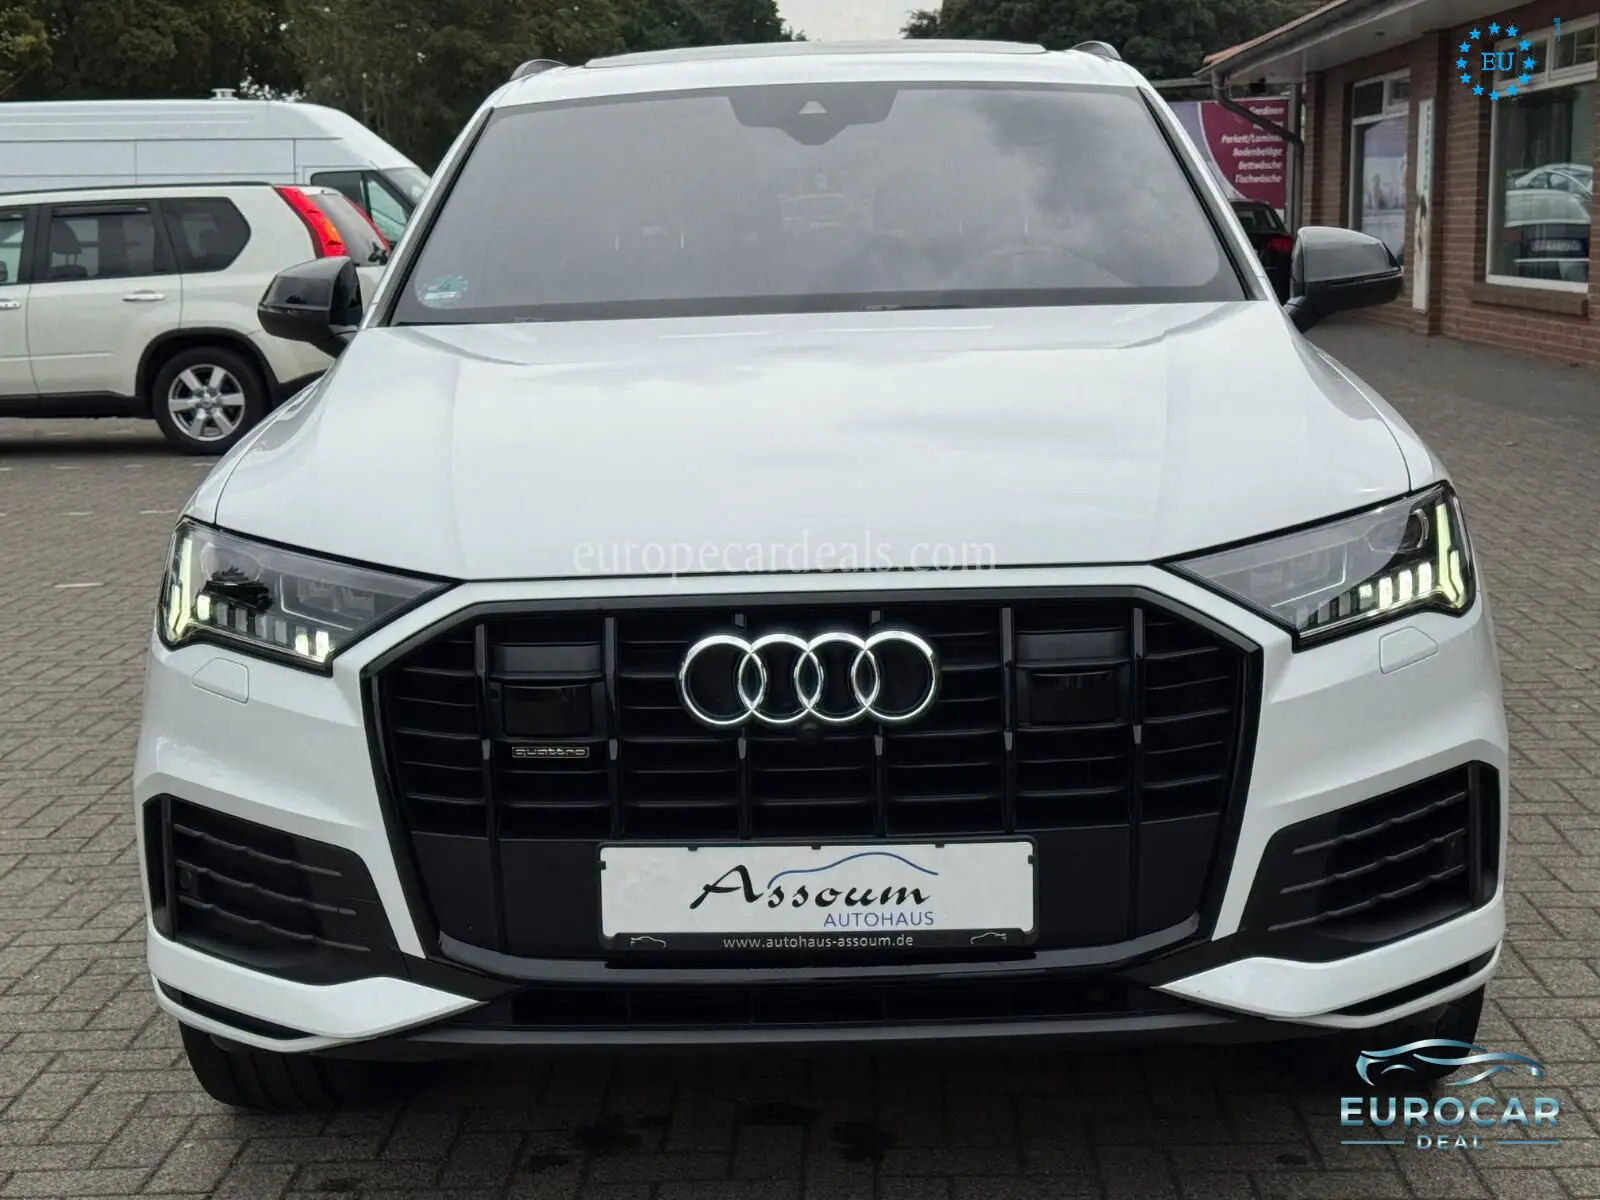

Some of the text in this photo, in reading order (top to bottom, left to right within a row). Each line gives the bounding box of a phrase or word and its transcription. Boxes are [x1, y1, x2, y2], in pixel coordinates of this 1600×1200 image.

[515, 748, 585, 757] quattro
[689, 864, 930, 909] Assoum
[823, 911, 935, 928] AUTOHAUS
[722, 933, 914, 949] www.autohaus-assoum.de
